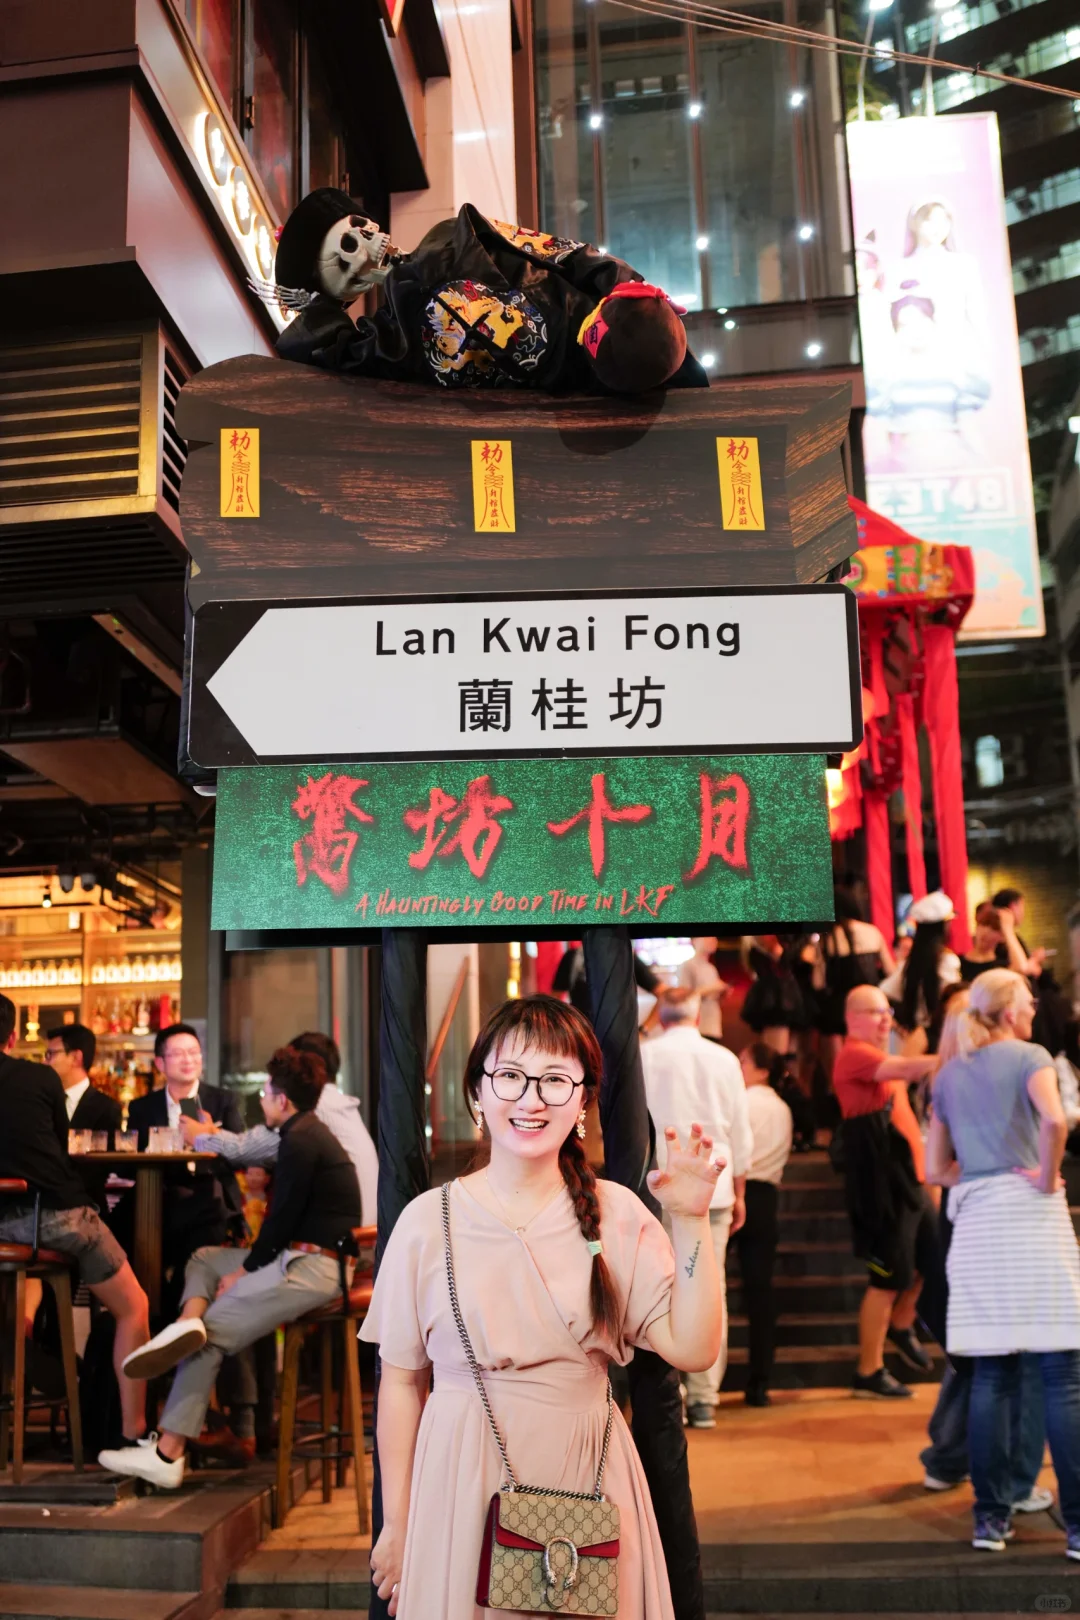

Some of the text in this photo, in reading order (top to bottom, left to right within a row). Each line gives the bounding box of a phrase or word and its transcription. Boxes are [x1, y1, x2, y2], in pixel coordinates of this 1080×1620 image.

[376, 614, 740, 657] Lan Kwai Fong
[458, 675, 665, 733] 蘭桂坊
[291, 772, 750, 896] 驚坊十月
[354, 892, 369, 920] A
[375, 888, 485, 917] HAUNTINGLY
[490, 890, 544, 912] GOOD
[619, 884, 675, 917] LKF
